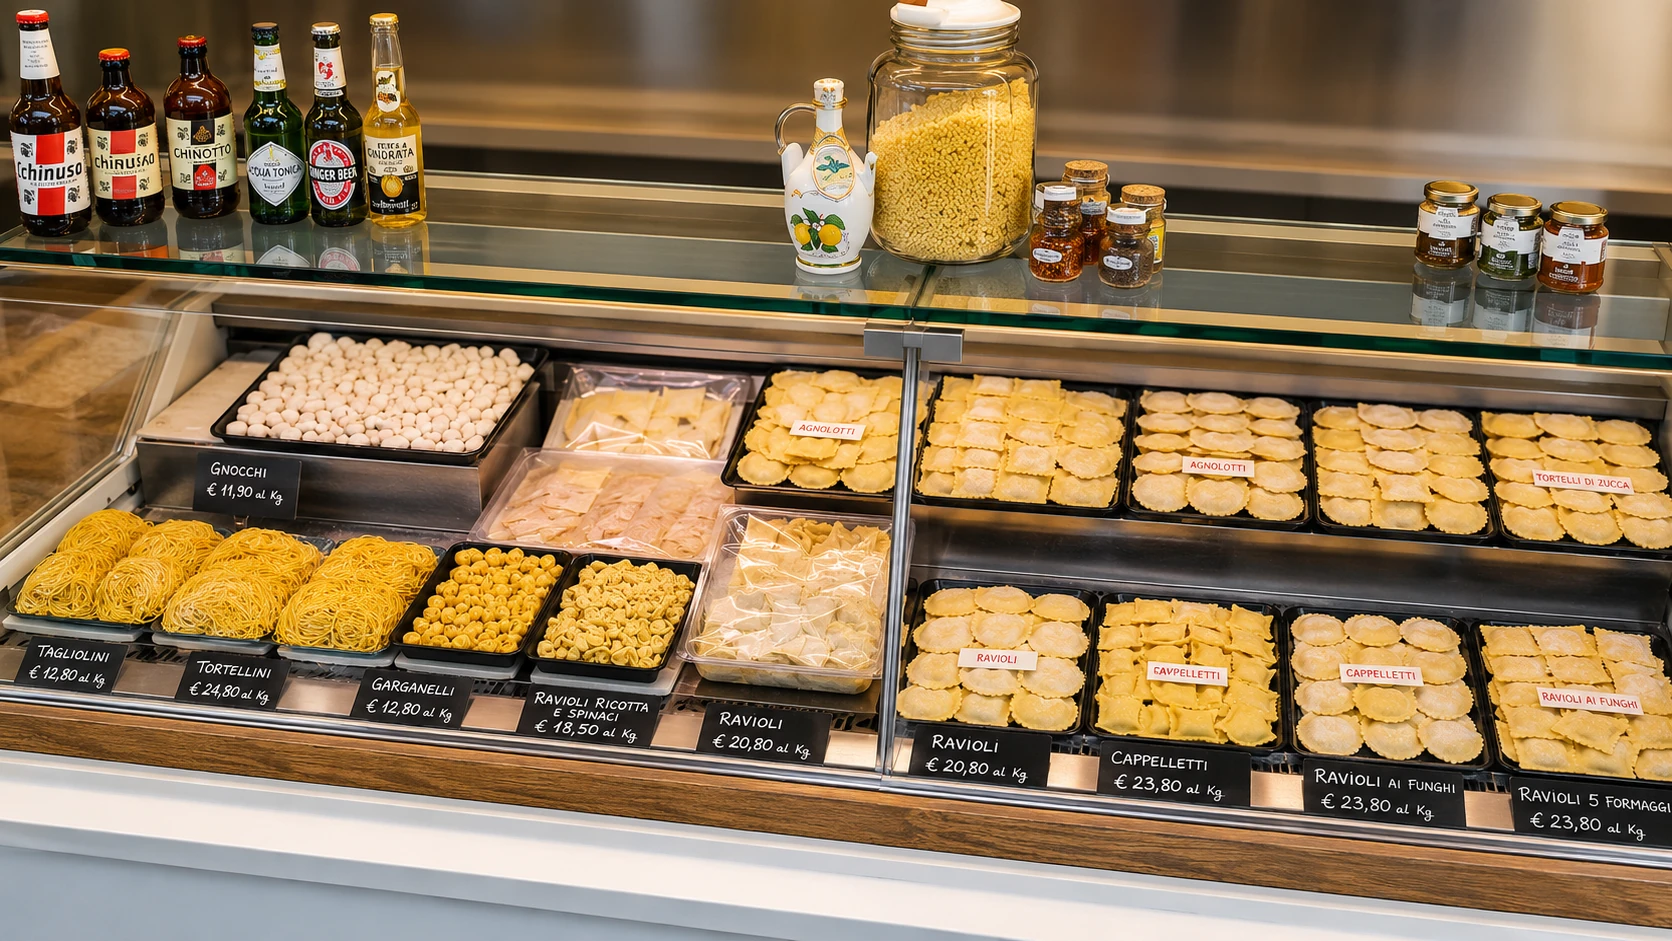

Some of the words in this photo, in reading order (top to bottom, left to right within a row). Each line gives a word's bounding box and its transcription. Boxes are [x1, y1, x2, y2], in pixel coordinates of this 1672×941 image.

[174, 144, 232, 160] CHINOTTO
[798, 424, 856, 435] AGNOLOTTI
[210, 462, 267, 478] GNOCCHI
[1190, 461, 1246, 472] AGNOLOTTI
[1536, 473, 1581, 485] TORTELLI
[1584, 478, 1595, 486] DI
[207, 482, 217, 497] €
[221, 484, 253, 499] 11,90
[256, 490, 266, 499] al
[270, 490, 283, 506] Kg
[38, 645, 110, 663] TAGLIOLINI
[976, 654, 1018, 664] RAVIOLI
[29, 665, 41, 679] €
[43, 667, 78, 682] 12,80
[78, 673, 90, 683] al
[92, 674, 106, 689] Kg
[197, 660, 272, 679] TORTELLINI
[1346, 668, 1416, 680] CAPPELLETTI
[189, 682, 201, 696] €
[202, 683, 240, 699] 24,80
[241, 690, 253, 699] al
[256, 690, 270, 705] Kg
[372, 678, 455, 696] GARGANELLI
[534, 692, 589, 708] RAVIOLI
[595, 698, 649, 713] RICOTTA
[1542, 692, 1582, 704] RAVIOLI
[1586, 696, 1597, 705] AI
[1600, 697, 1638, 709] FUNGHI
[366, 699, 378, 713] €
[382, 700, 421, 716] 12,80
[422, 708, 435, 717] al
[439, 708, 452, 723] Kg
[553, 708, 562, 717] E
[568, 709, 619, 722] SPINACI
[720, 712, 783, 730] RAVIOLI
[534, 720, 548, 733] €
[553, 721, 599, 737] 18,50
[602, 728, 616, 737] al
[622, 728, 638, 744] Kg
[712, 734, 726, 748] €
[728, 736, 773, 752] 20,80
[776, 744, 789, 753] al
[794, 744, 811, 760] Kg
[925, 757, 939, 772] €
[943, 760, 989, 776] 20,80
[992, 767, 1006, 777] al
[1012, 768, 1028, 784] Kg
[1111, 751, 1208, 771] CAPPELLETTI
[1114, 774, 1128, 789] €
[1132, 776, 1182, 794] 23,80
[1186, 784, 1200, 794] al
[1206, 784, 1225, 802] Kg
[1388, 779, 1401, 789] AI
[1408, 780, 1456, 794] FUNGHI
[1321, 793, 1335, 809] €
[1340, 795, 1391, 813] 23,80
[1396, 804, 1410, 814] al
[1416, 804, 1435, 822] Kg
[1589, 794, 1599, 807] 5
[1606, 796, 1672, 813] FORMAGGI
[1530, 812, 1544, 828] €
[1550, 814, 1601, 833] 23,80
[1607, 823, 1621, 834] al
[1628, 824, 1646, 841] Kg
